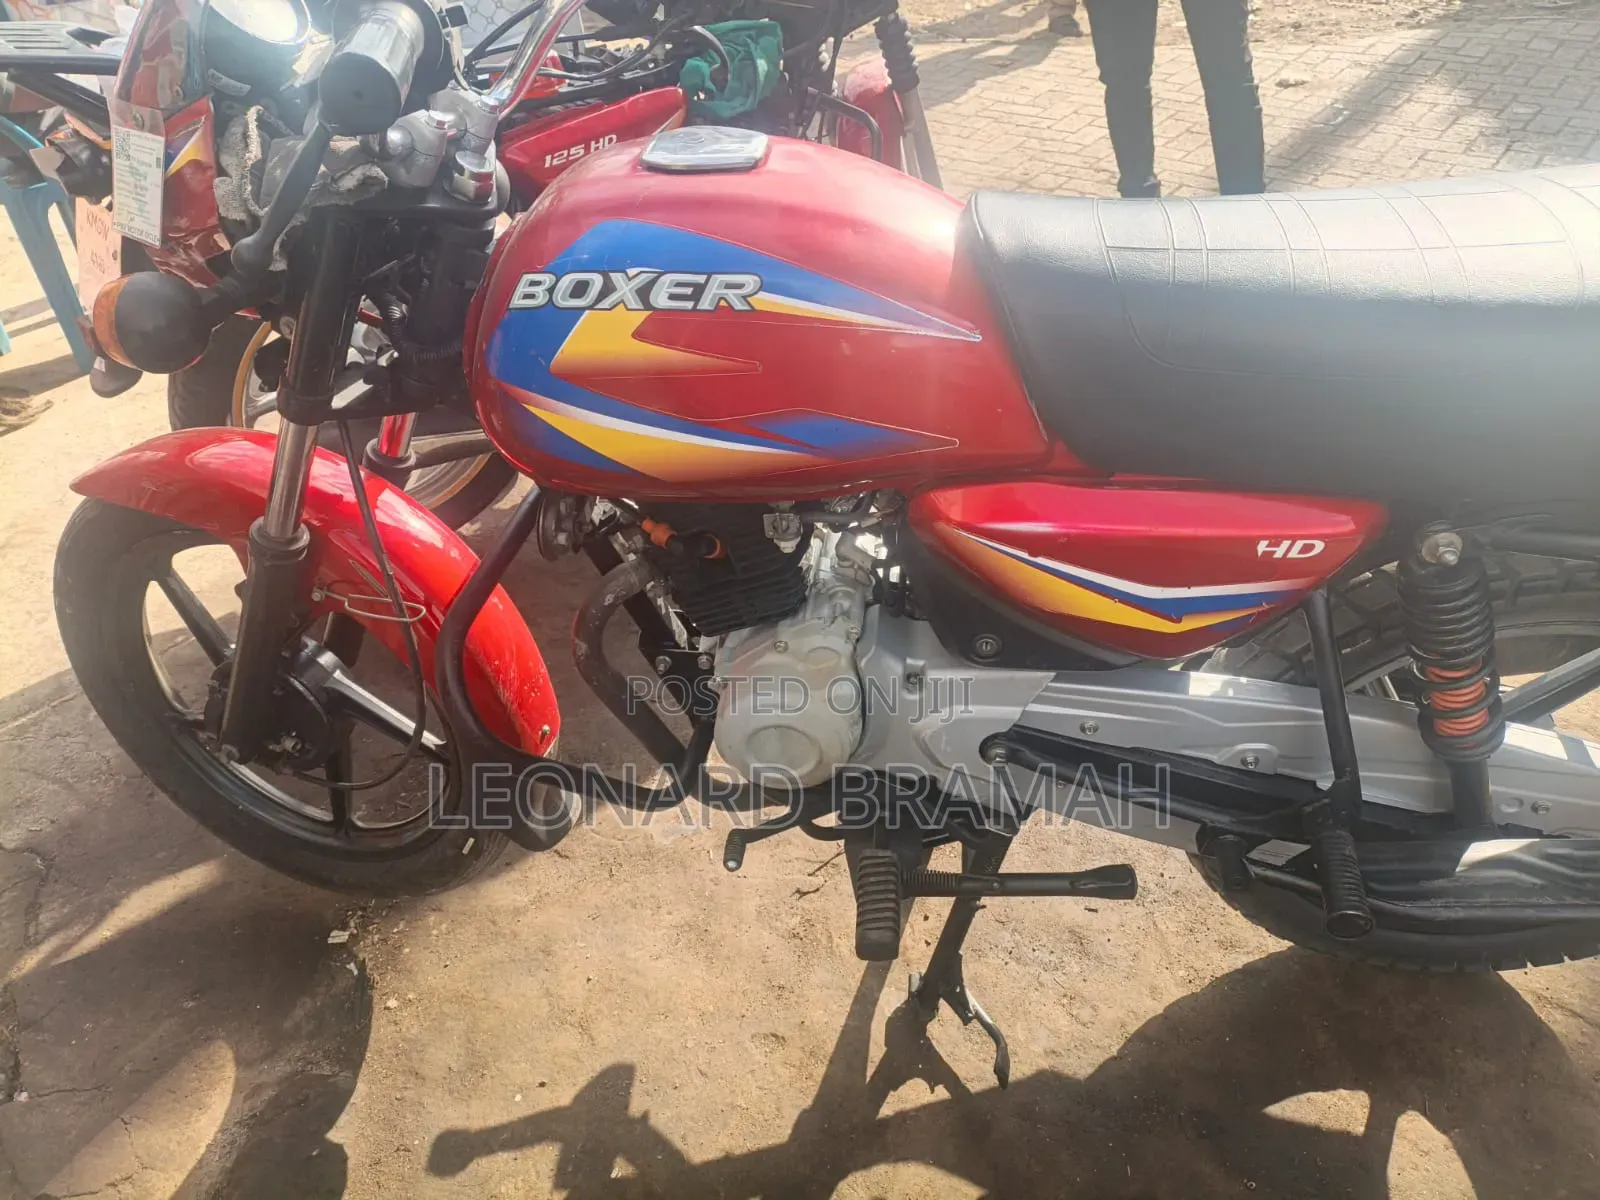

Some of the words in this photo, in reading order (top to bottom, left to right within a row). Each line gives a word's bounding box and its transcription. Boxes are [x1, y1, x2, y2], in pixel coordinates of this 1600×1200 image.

[544, 144, 585, 168] 125
[590, 134, 617, 153] HD
[508, 272, 763, 311] BOXER
[1257, 539, 1325, 560] HD
